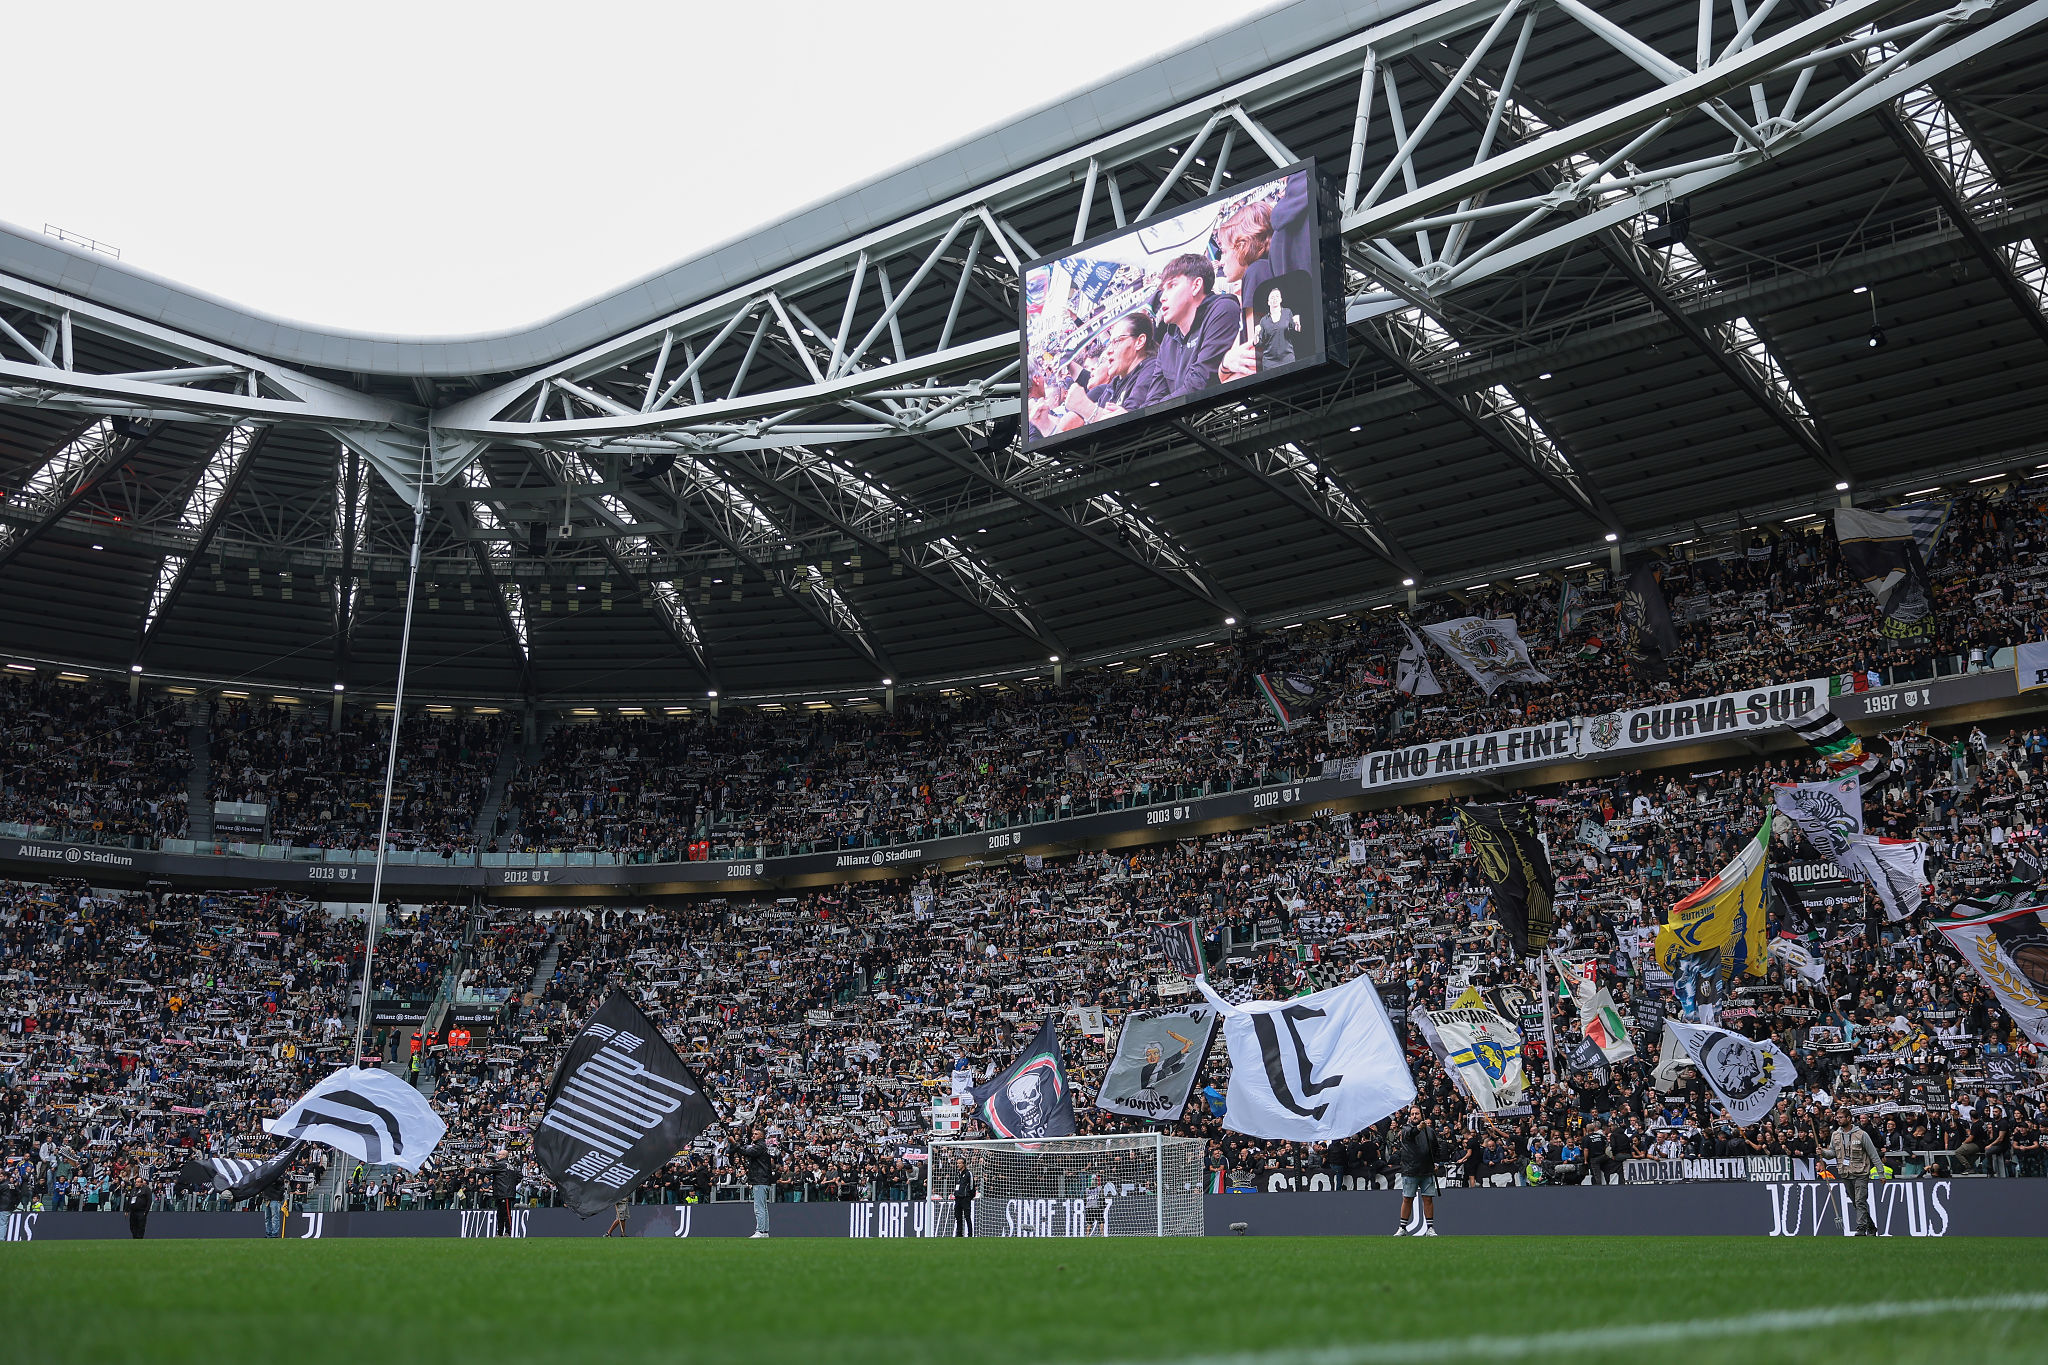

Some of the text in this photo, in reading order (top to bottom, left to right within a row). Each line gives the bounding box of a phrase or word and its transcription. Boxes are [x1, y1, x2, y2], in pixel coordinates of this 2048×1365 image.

[1864, 694, 1898, 714] 1997
[1628, 686, 1816, 744] CURVA SUD
[1369, 747, 1429, 784] FINO
[1435, 736, 1505, 773] ALLA
[1507, 725, 1570, 761] FINE
[1253, 791, 1279, 808] 2002
[1147, 809, 1170, 825] 2003
[988, 834, 1010, 849] 2005
[18, 845, 133, 866] Allianz Stadium
[836, 849, 921, 867] Allianz Stadium
[309, 867, 335, 880] 2013
[504, 871, 528, 883] 2012
[727, 865, 751, 877] 2006
[1628, 1160, 1683, 1182] ANDRIA
[1684, 1158, 1747, 1179] BARLETTA
[850, 1202, 874, 1238] WE
[878, 1202, 909, 1238] ARE
[1001, 1198, 1113, 1238] SINCE 187
